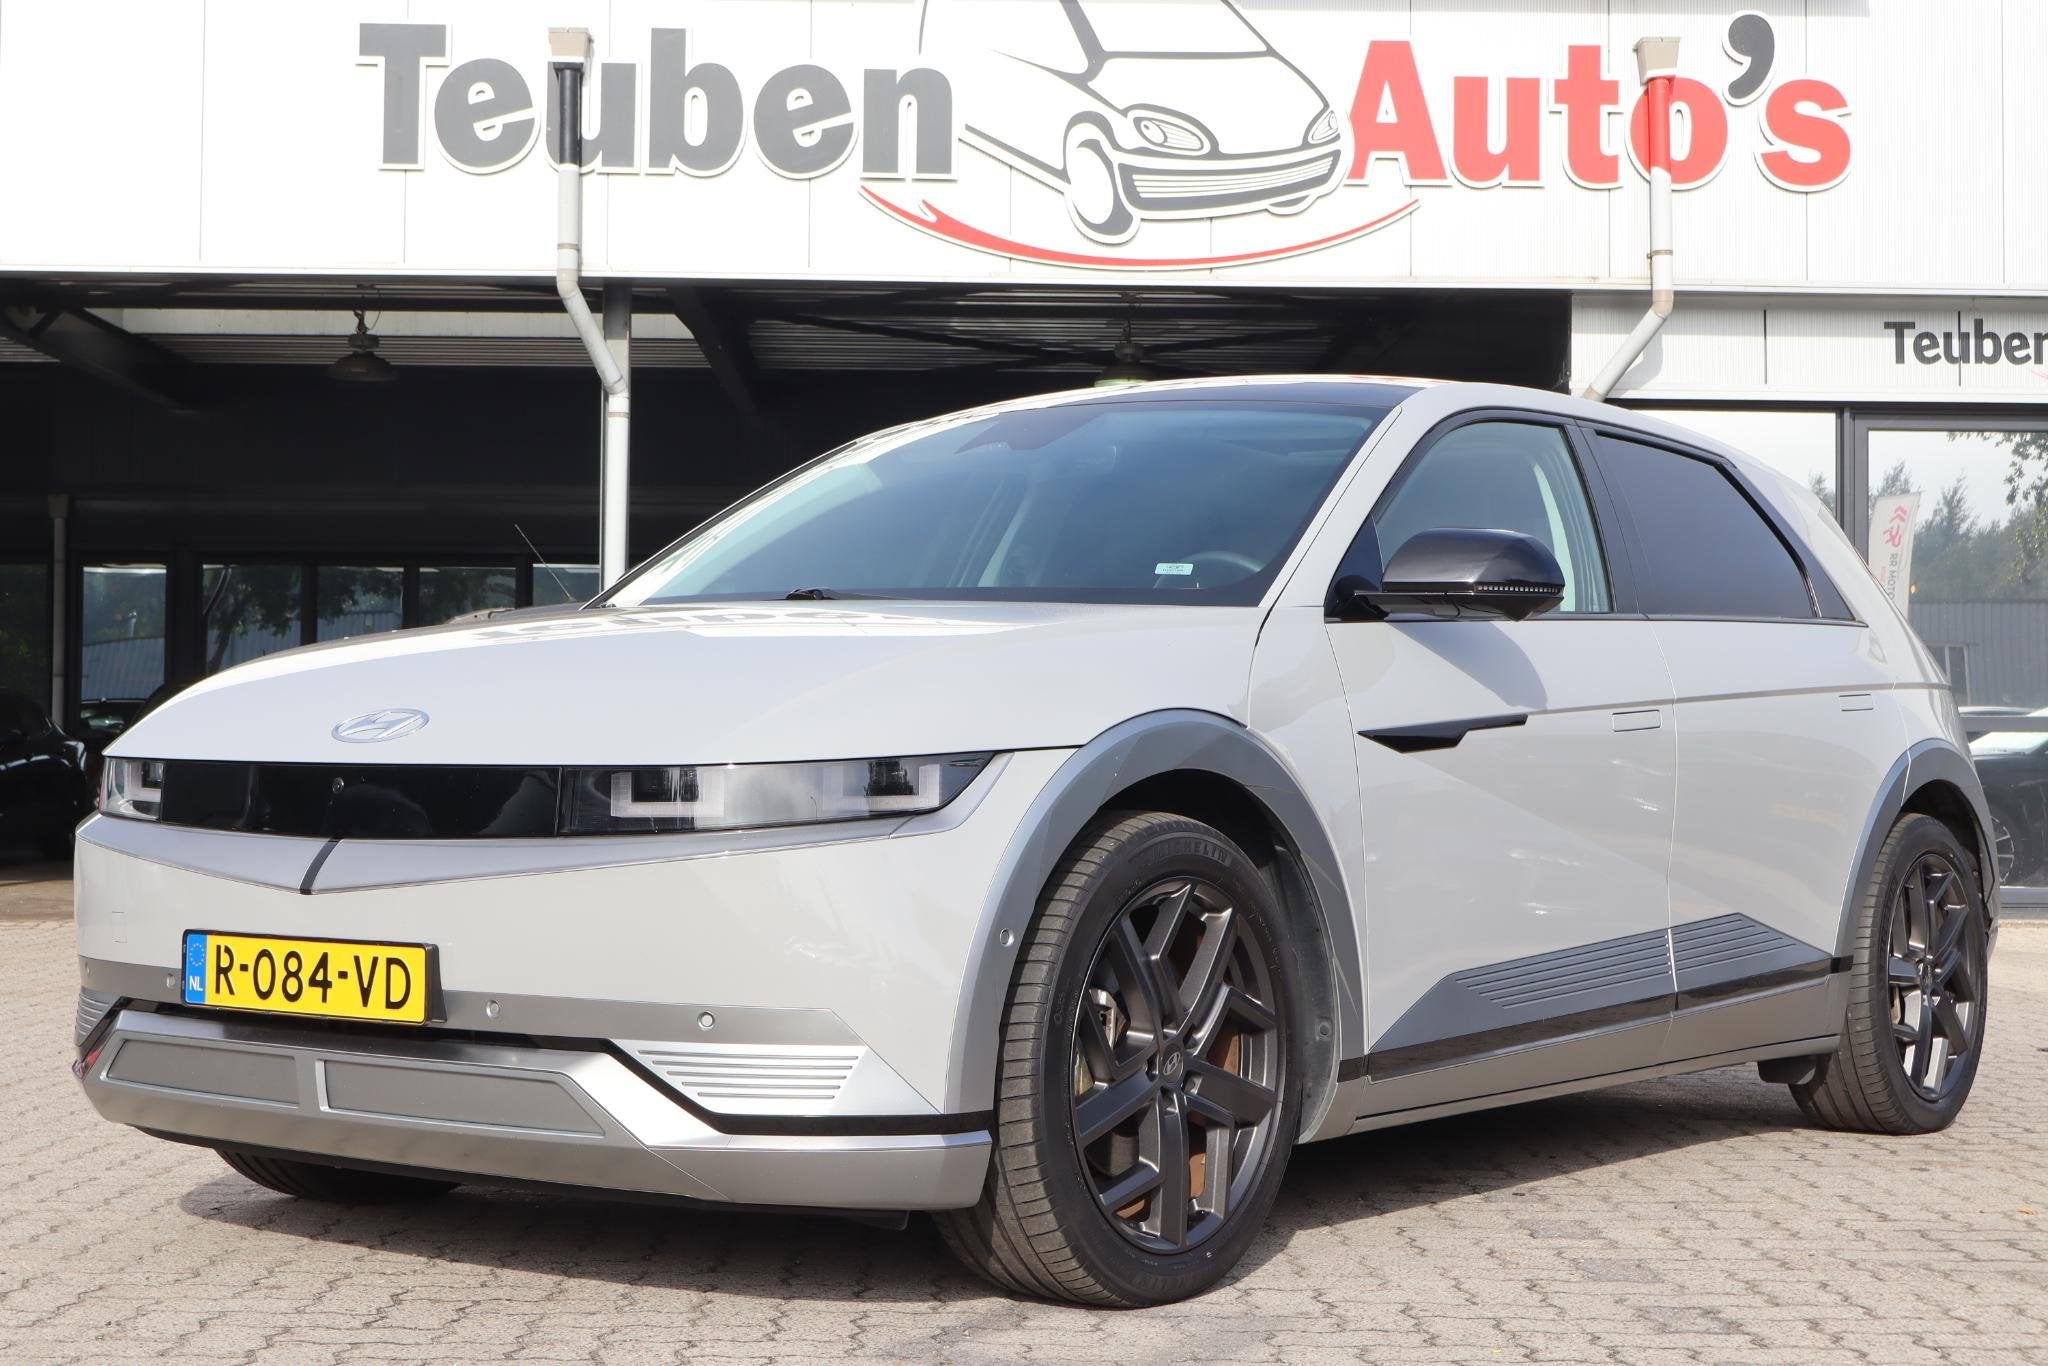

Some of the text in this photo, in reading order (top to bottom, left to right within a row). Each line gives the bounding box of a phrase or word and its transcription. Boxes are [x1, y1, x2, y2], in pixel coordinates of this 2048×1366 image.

[357, 12, 1853, 190] Teuben Auto's
[189, 975, 204, 992] NL
[214, 944, 412, 1010] R-084-VD
